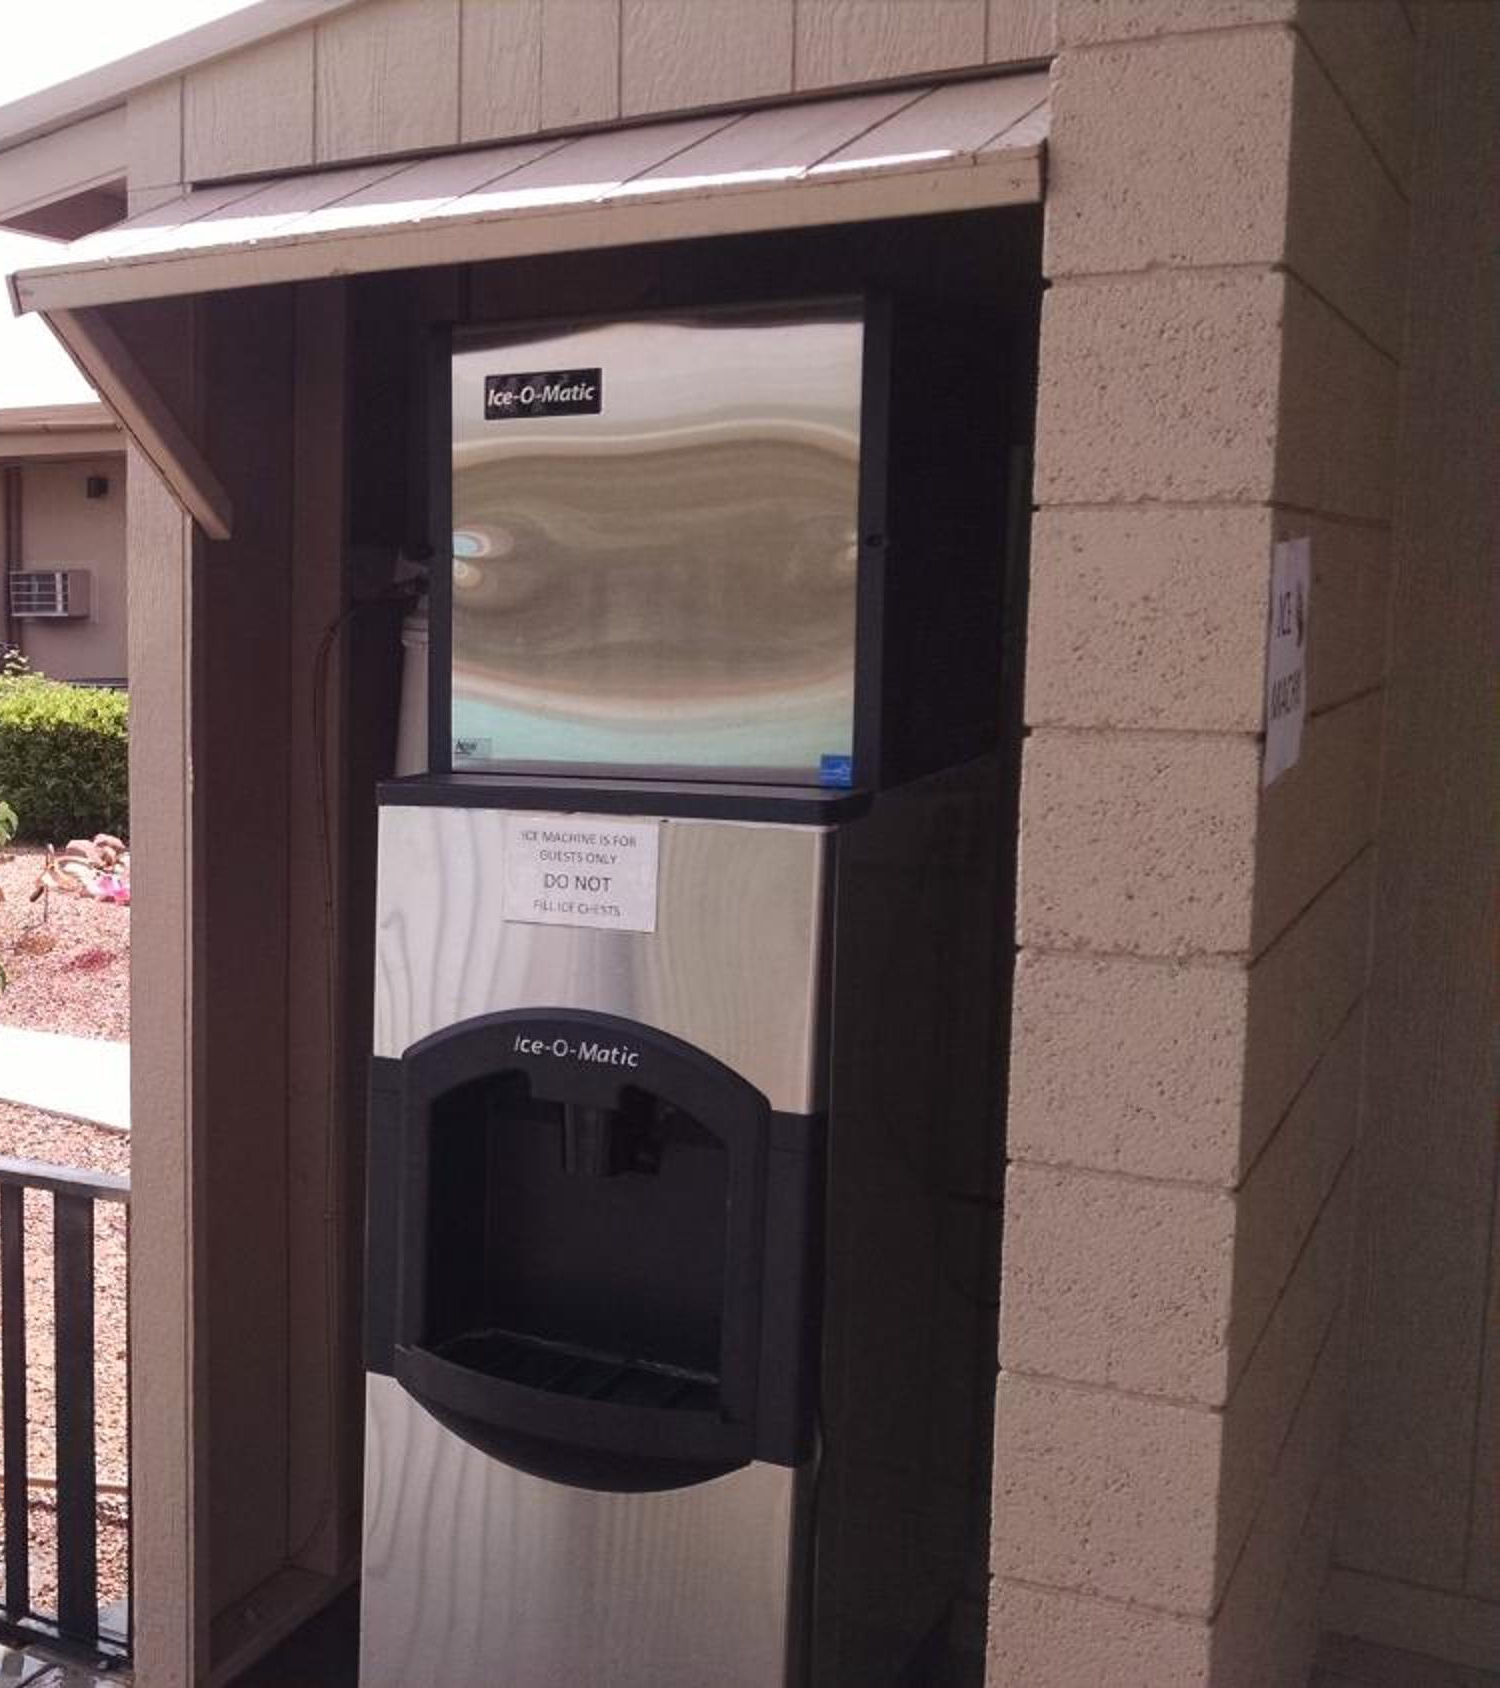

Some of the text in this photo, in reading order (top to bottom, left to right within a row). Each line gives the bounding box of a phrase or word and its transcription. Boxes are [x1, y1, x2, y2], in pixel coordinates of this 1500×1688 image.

[487, 383, 596, 407] Ice-O-Matic
[521, 830, 637, 848] ICE MACHINE IS FOR
[539, 850, 618, 865] GUESTS ONLY
[543, 873, 612, 892] DO NOT
[533, 900, 621, 917] FILL ICE CHESTS
[514, 1033, 639, 1067] Ice-O-Matic
